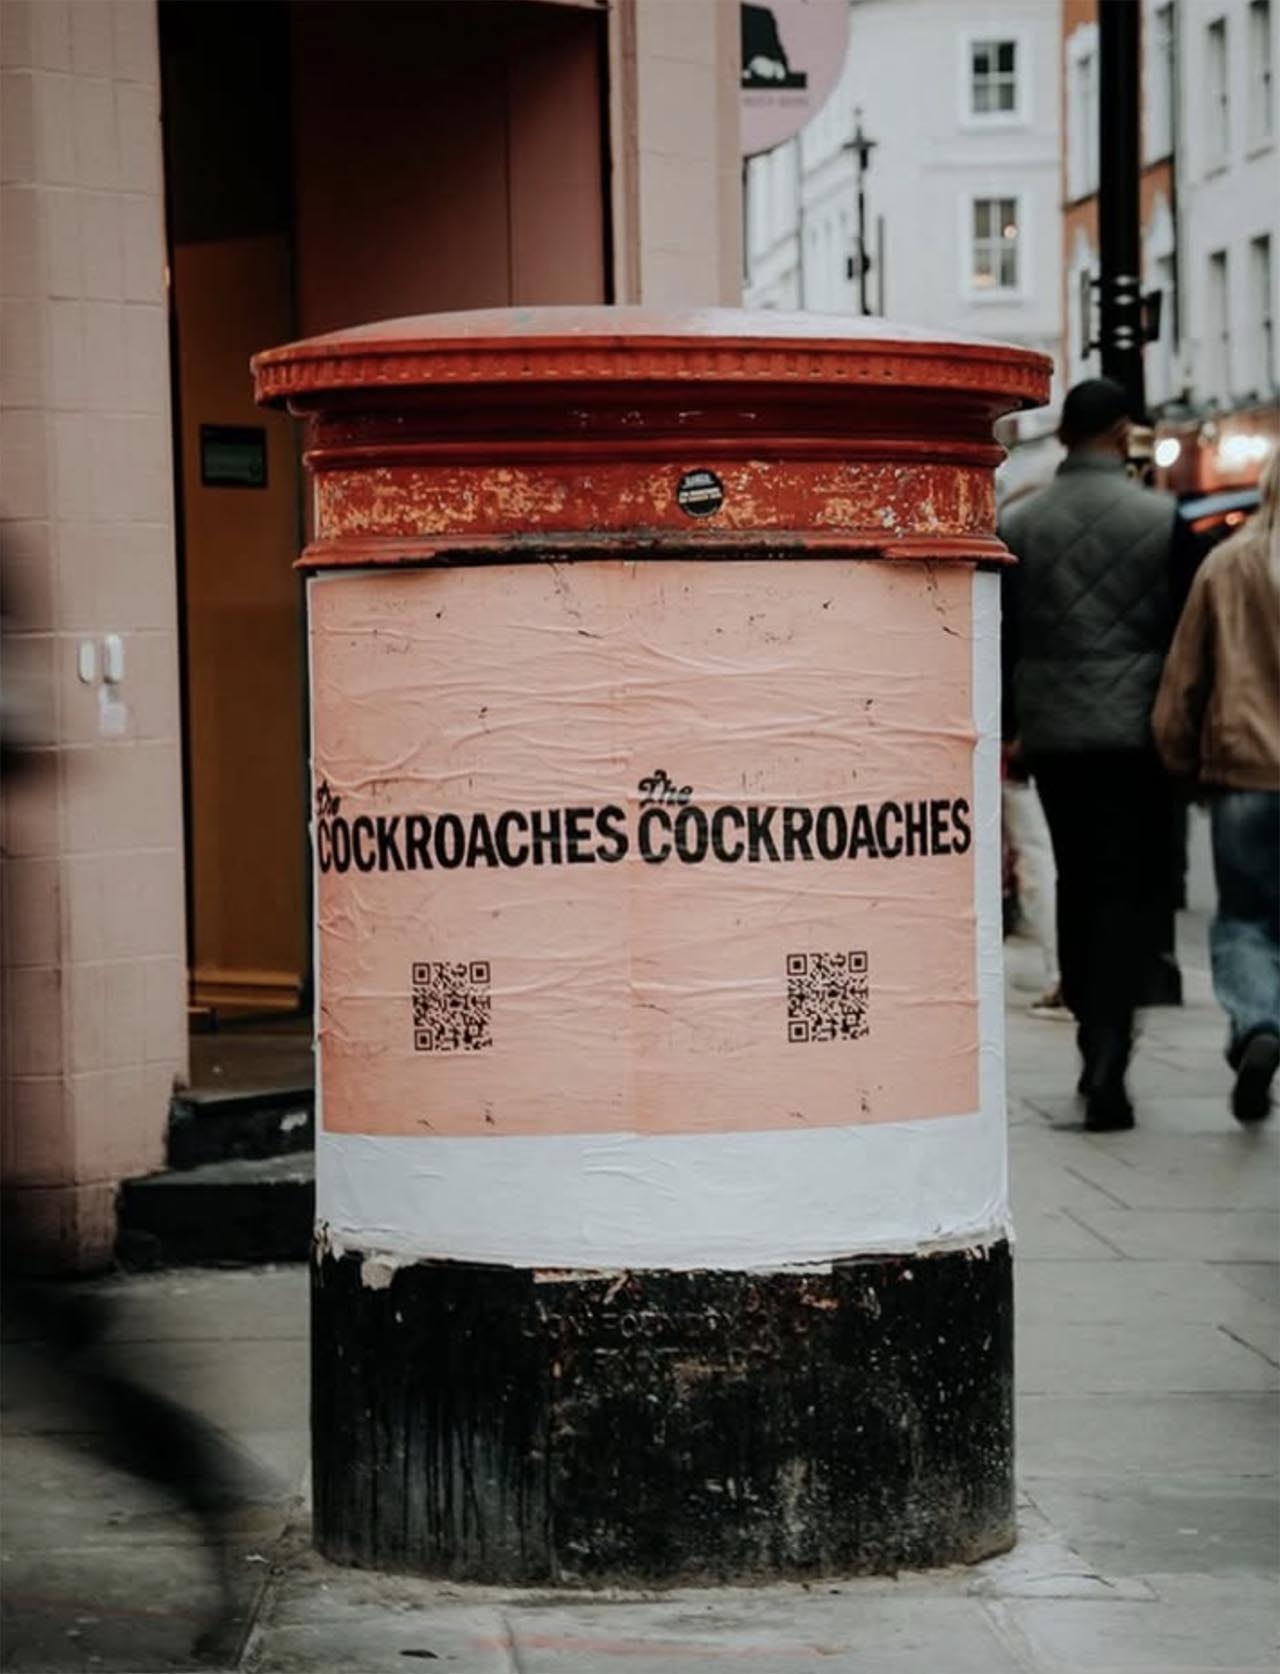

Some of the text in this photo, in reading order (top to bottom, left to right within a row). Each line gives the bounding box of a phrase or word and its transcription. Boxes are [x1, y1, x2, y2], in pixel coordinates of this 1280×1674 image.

[638, 769, 693, 809] The
[317, 804, 630, 873] COCKROACHES
[638, 798, 972, 864] COCKROACHES
